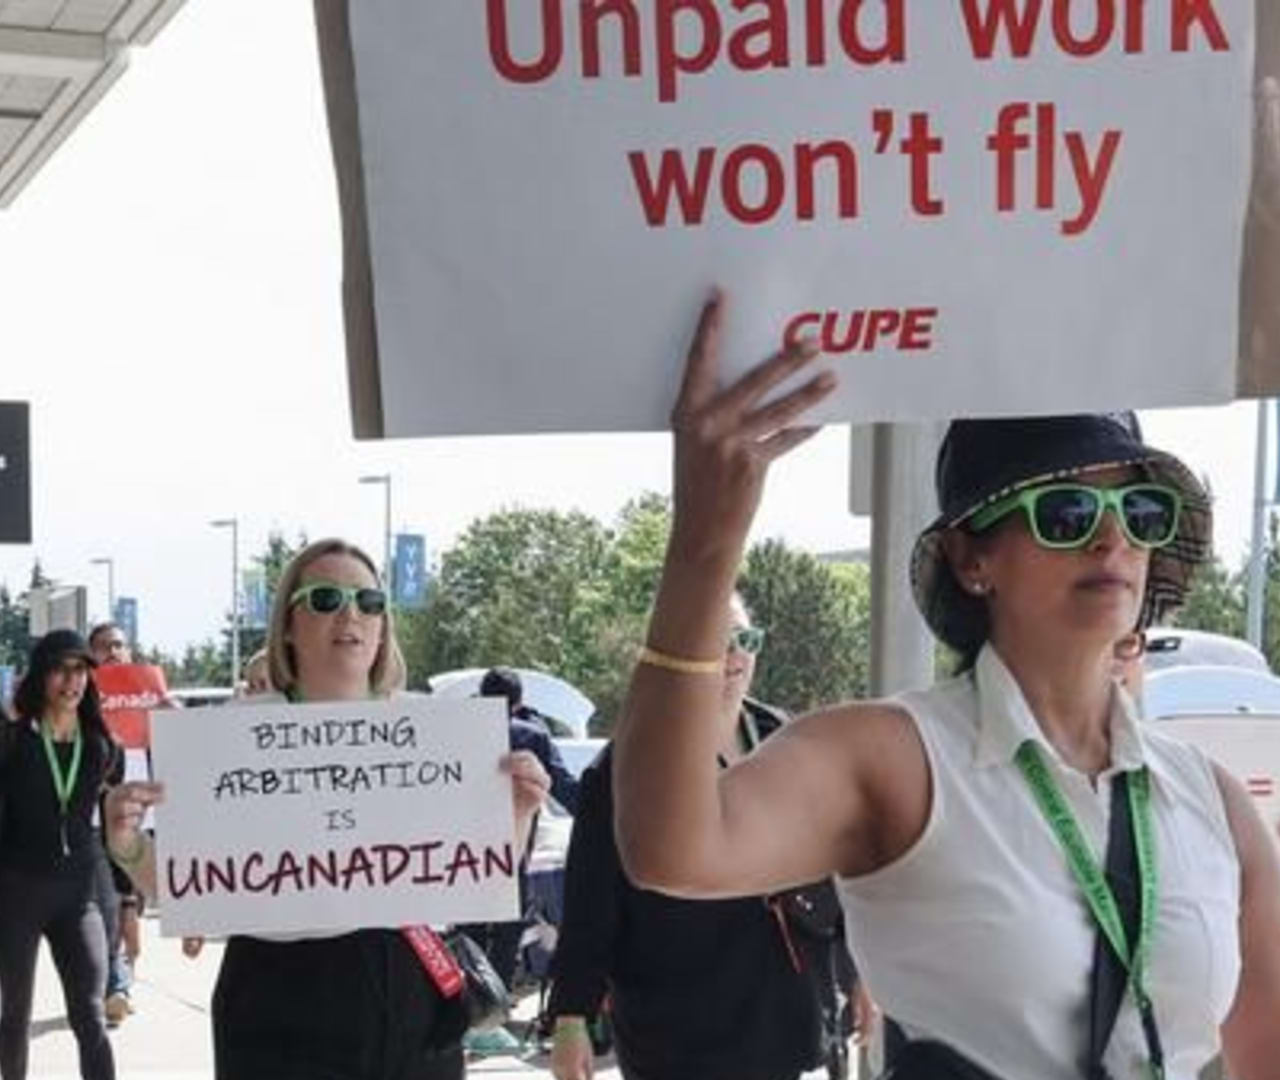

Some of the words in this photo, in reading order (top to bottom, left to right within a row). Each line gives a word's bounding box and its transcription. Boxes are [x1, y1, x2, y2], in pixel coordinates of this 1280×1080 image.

[485, 0, 907, 103] Unpaid
[958, 0, 1231, 61] work
[627, 108, 944, 227] won't
[985, 102, 1122, 235] fly
[781, 307, 939, 354] CUPE
[250, 716, 417, 750] BINDING
[213, 760, 463, 798] ARBITRATION
[323, 808, 357, 830] IS
[166, 840, 514, 900] UNCANADIAN
